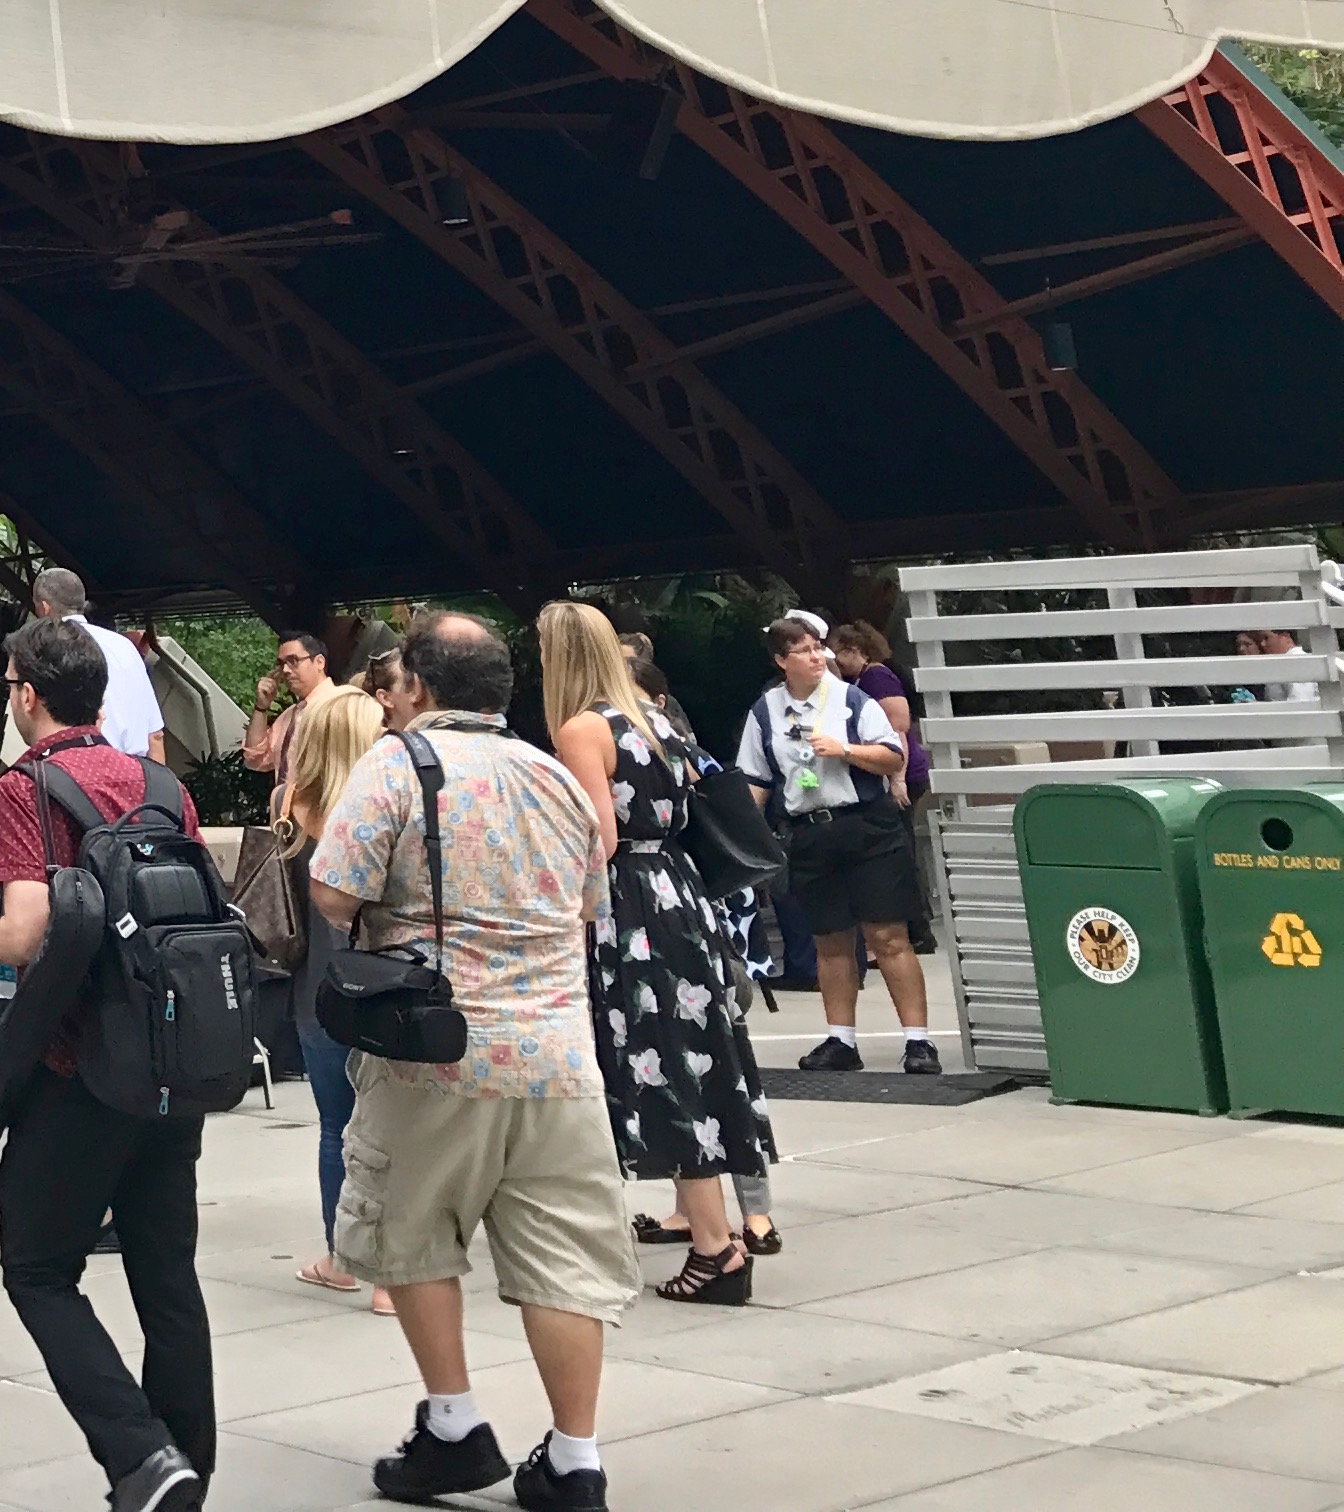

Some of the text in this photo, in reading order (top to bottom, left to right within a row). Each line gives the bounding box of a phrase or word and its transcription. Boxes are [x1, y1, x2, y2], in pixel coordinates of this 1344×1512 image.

[1213, 852, 1341, 870] BOTTLES AND CANS ONLY
[1069, 910, 1136, 944] PLEASE HELP KEEP
[220, 953, 239, 1010] THULE
[1073, 950, 1137, 981] OUR CITY CLEAN
